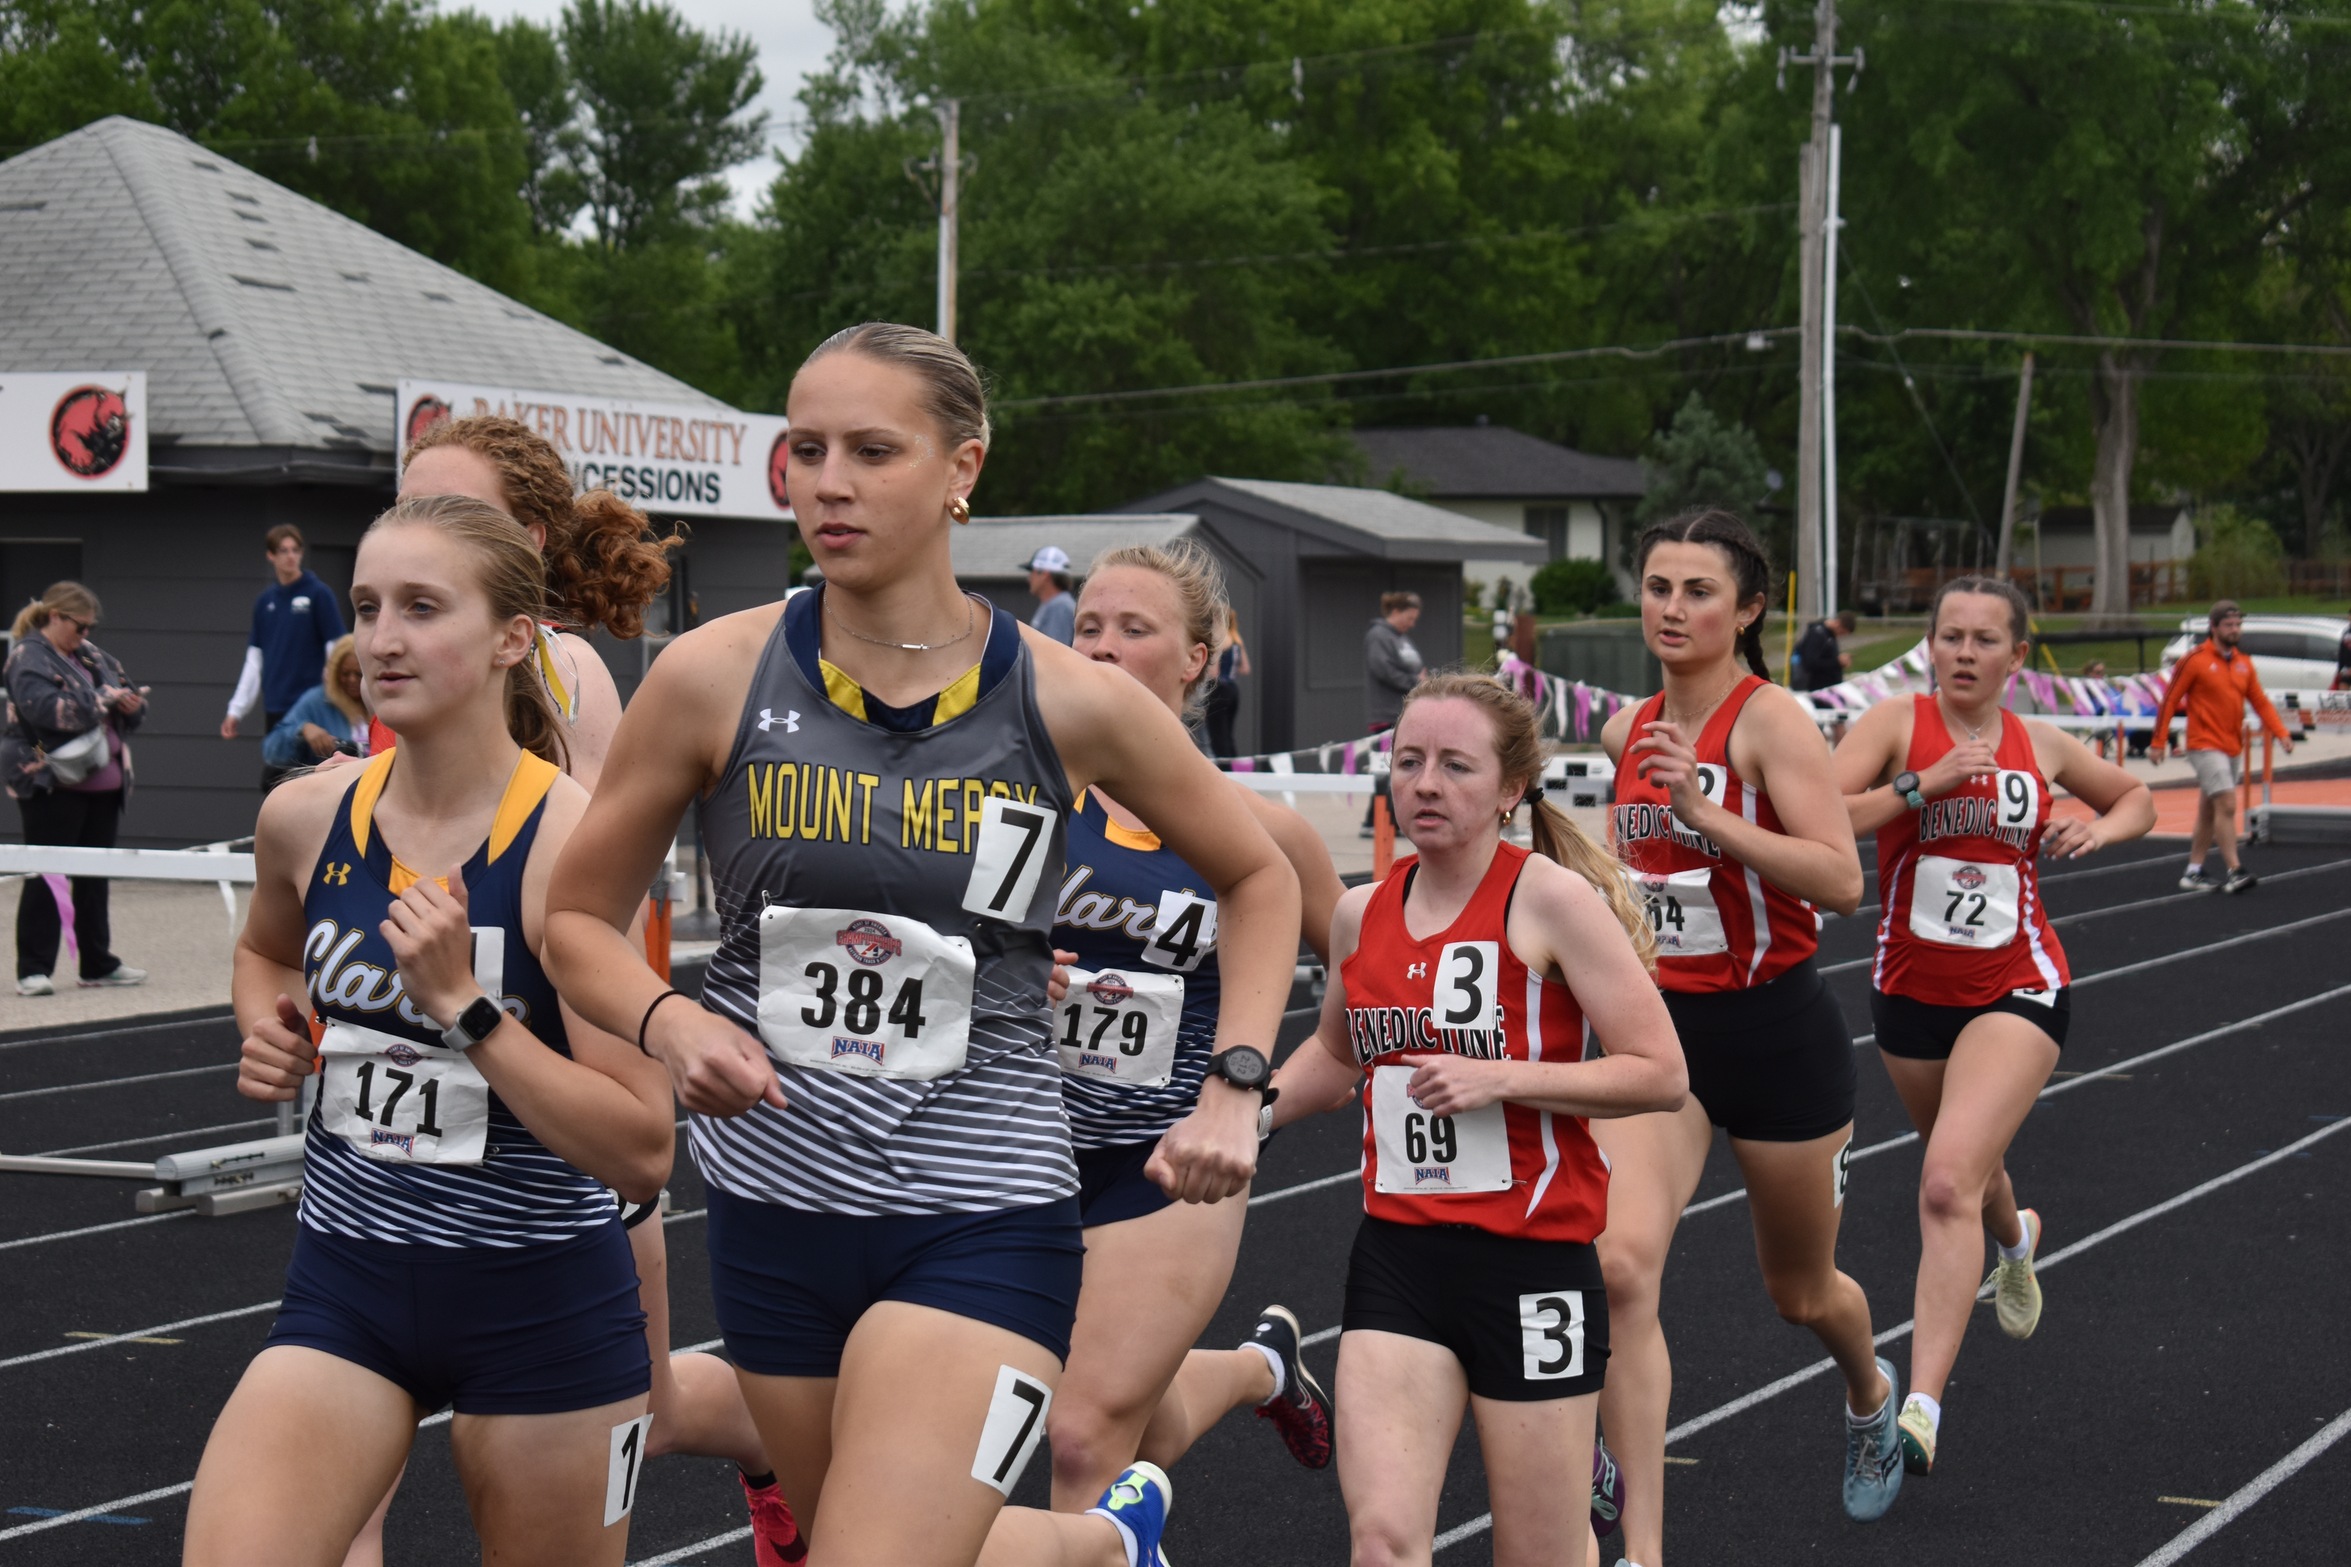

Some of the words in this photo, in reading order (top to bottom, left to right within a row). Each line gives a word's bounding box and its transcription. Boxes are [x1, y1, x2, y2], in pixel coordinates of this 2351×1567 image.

[577, 407, 747, 465] UNIVERSITY
[572, 460, 721, 503] CESSIONS
[748, 762, 880, 845] MOUNT
[902, 777, 1039, 854] MER
[2005, 772, 2029, 823] 9
[987, 807, 1045, 912] 7
[1613, 803, 1720, 859] NEDICT
[1053, 864, 1217, 953] lar
[1155, 902, 1205, 967] 4
[1944, 890, 1987, 927] 72
[303, 918, 531, 1029] Clar
[801, 961, 926, 1039] 384
[1445, 945, 1484, 1025] 3
[833, 1038, 882, 1062] NAIA
[1059, 1003, 1148, 1057] 179
[1080, 1053, 1116, 1071] NAIA
[354, 1060, 442, 1138] 171
[372, 1130, 413, 1155] NAIA
[1405, 1112, 1457, 1164] 69
[1415, 1168, 1449, 1181] NAIA
[1536, 1297, 1573, 1374] 3
[992, 1378, 1045, 1484] 7
[621, 1422, 640, 1511] 1
